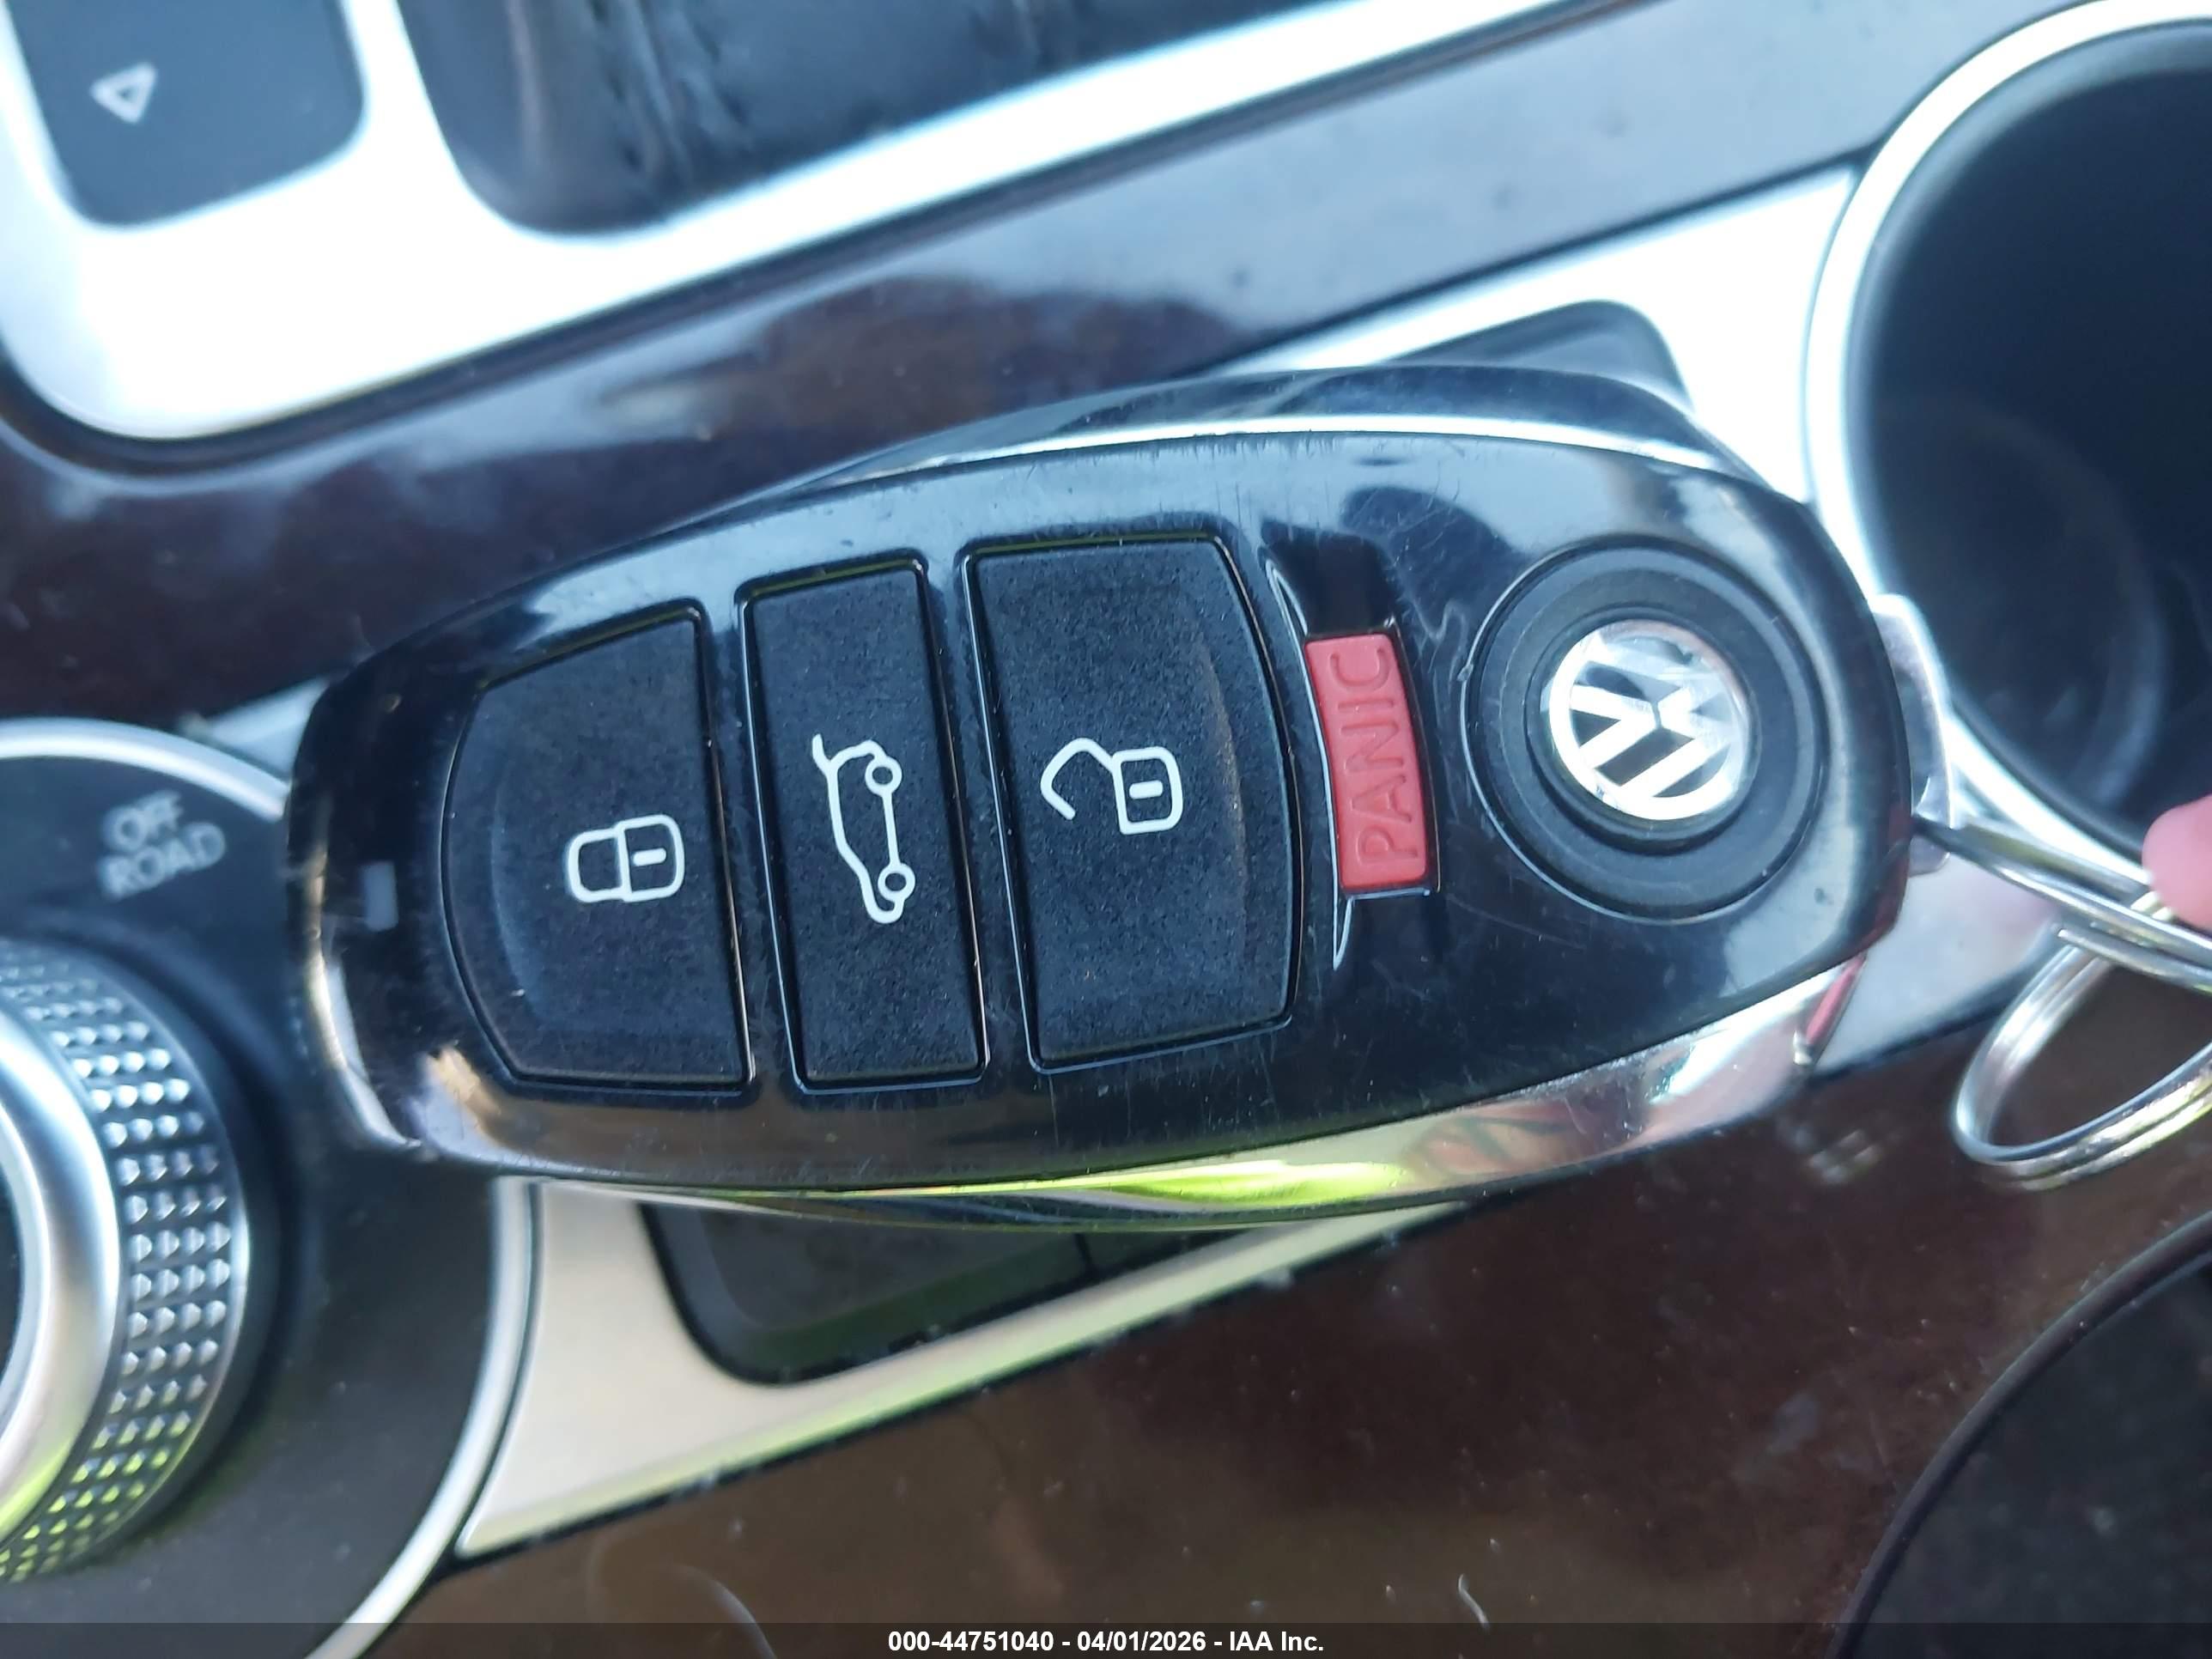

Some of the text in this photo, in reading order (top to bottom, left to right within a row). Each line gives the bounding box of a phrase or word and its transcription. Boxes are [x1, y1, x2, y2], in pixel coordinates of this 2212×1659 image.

[1330, 646, 1419, 862] PANIC
[97, 822, 225, 898] ROAD
[101, 791, 183, 853] OFF
